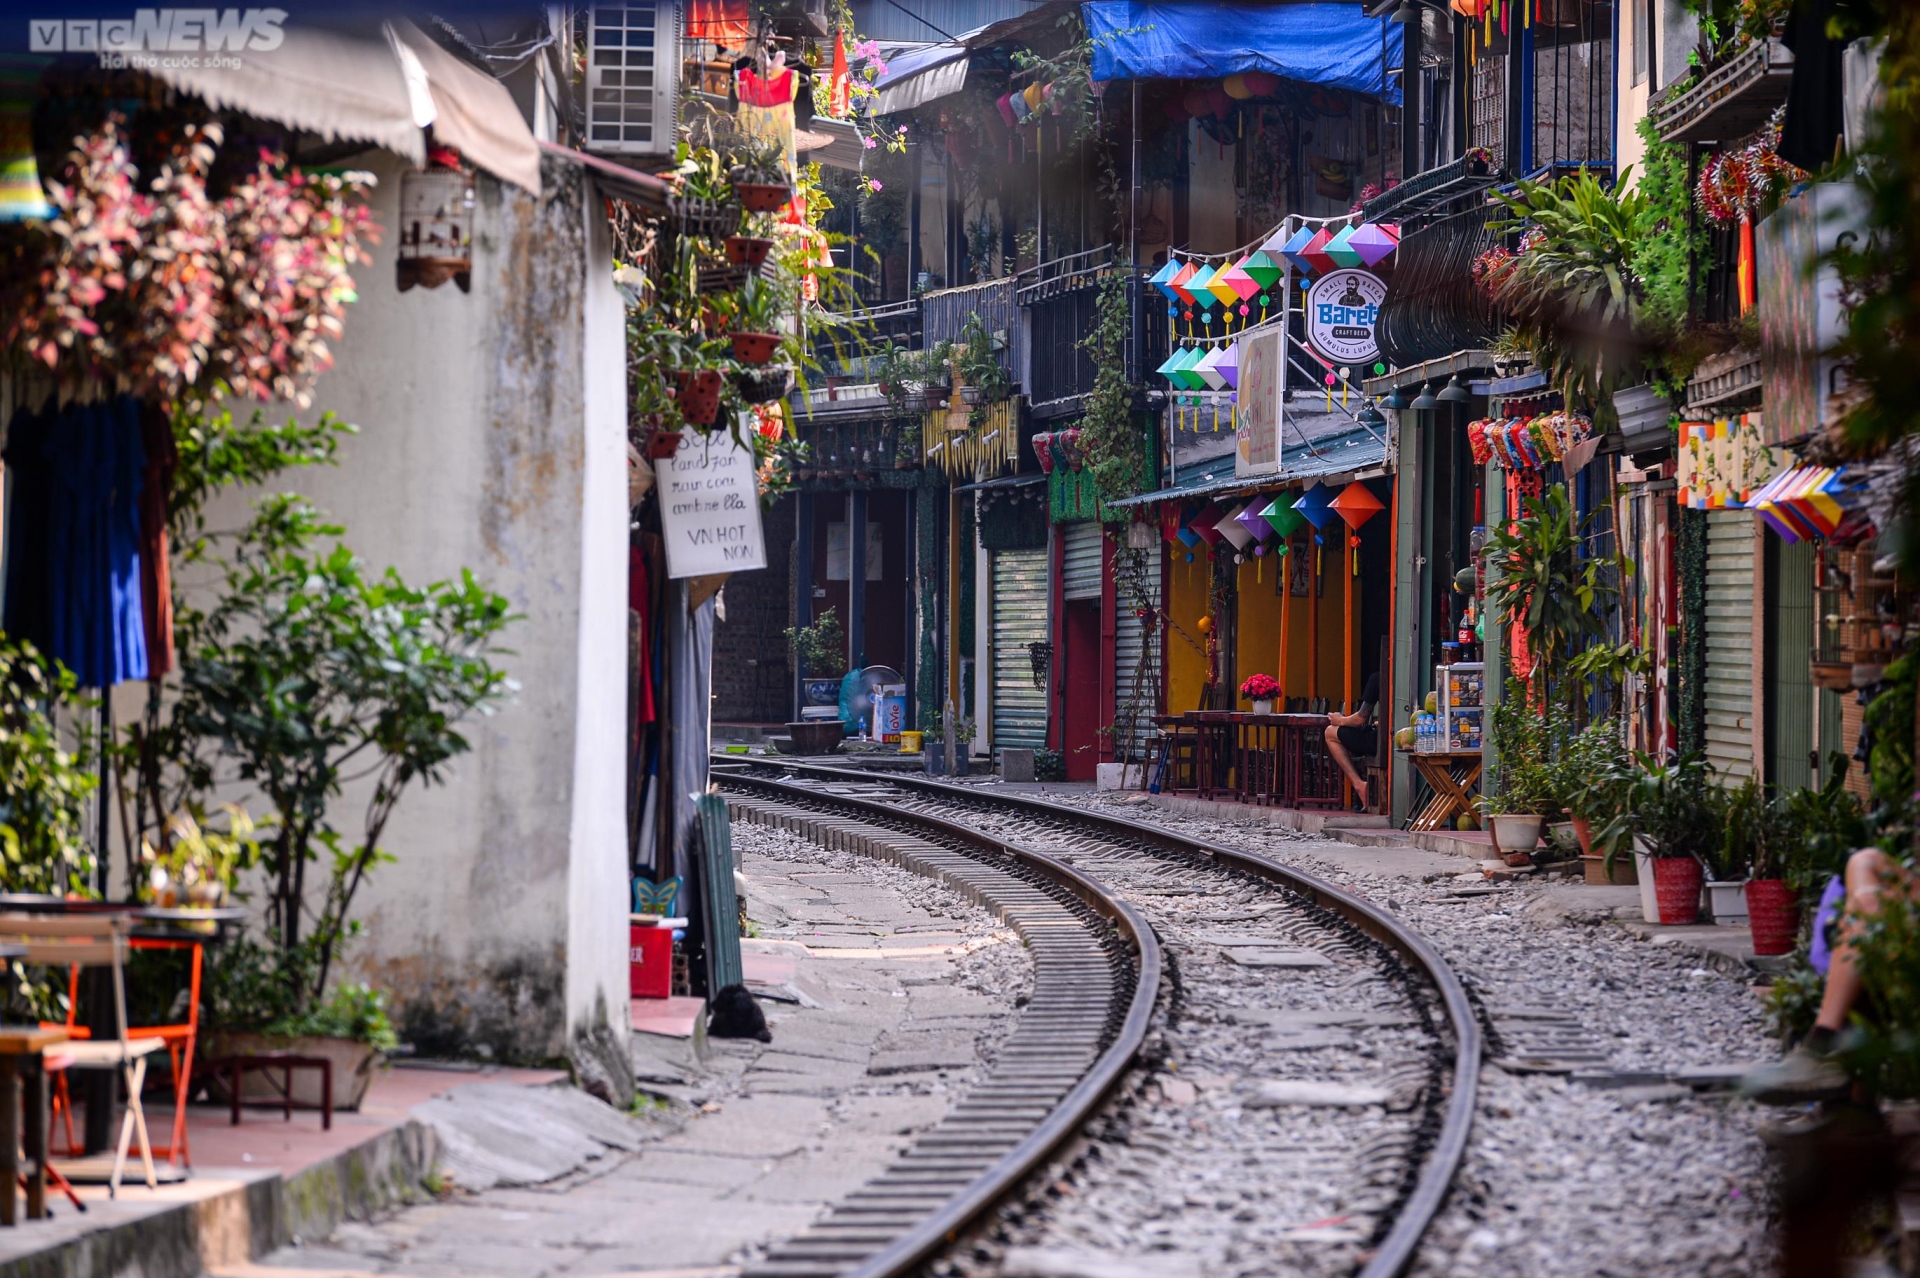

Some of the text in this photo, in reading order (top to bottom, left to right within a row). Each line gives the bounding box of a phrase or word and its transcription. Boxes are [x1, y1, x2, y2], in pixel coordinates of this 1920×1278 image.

[1320, 280, 1383, 300] SMALL BATCH
[1319, 331, 1350, 354] HUMULUS
[723, 545, 754, 561] NON
